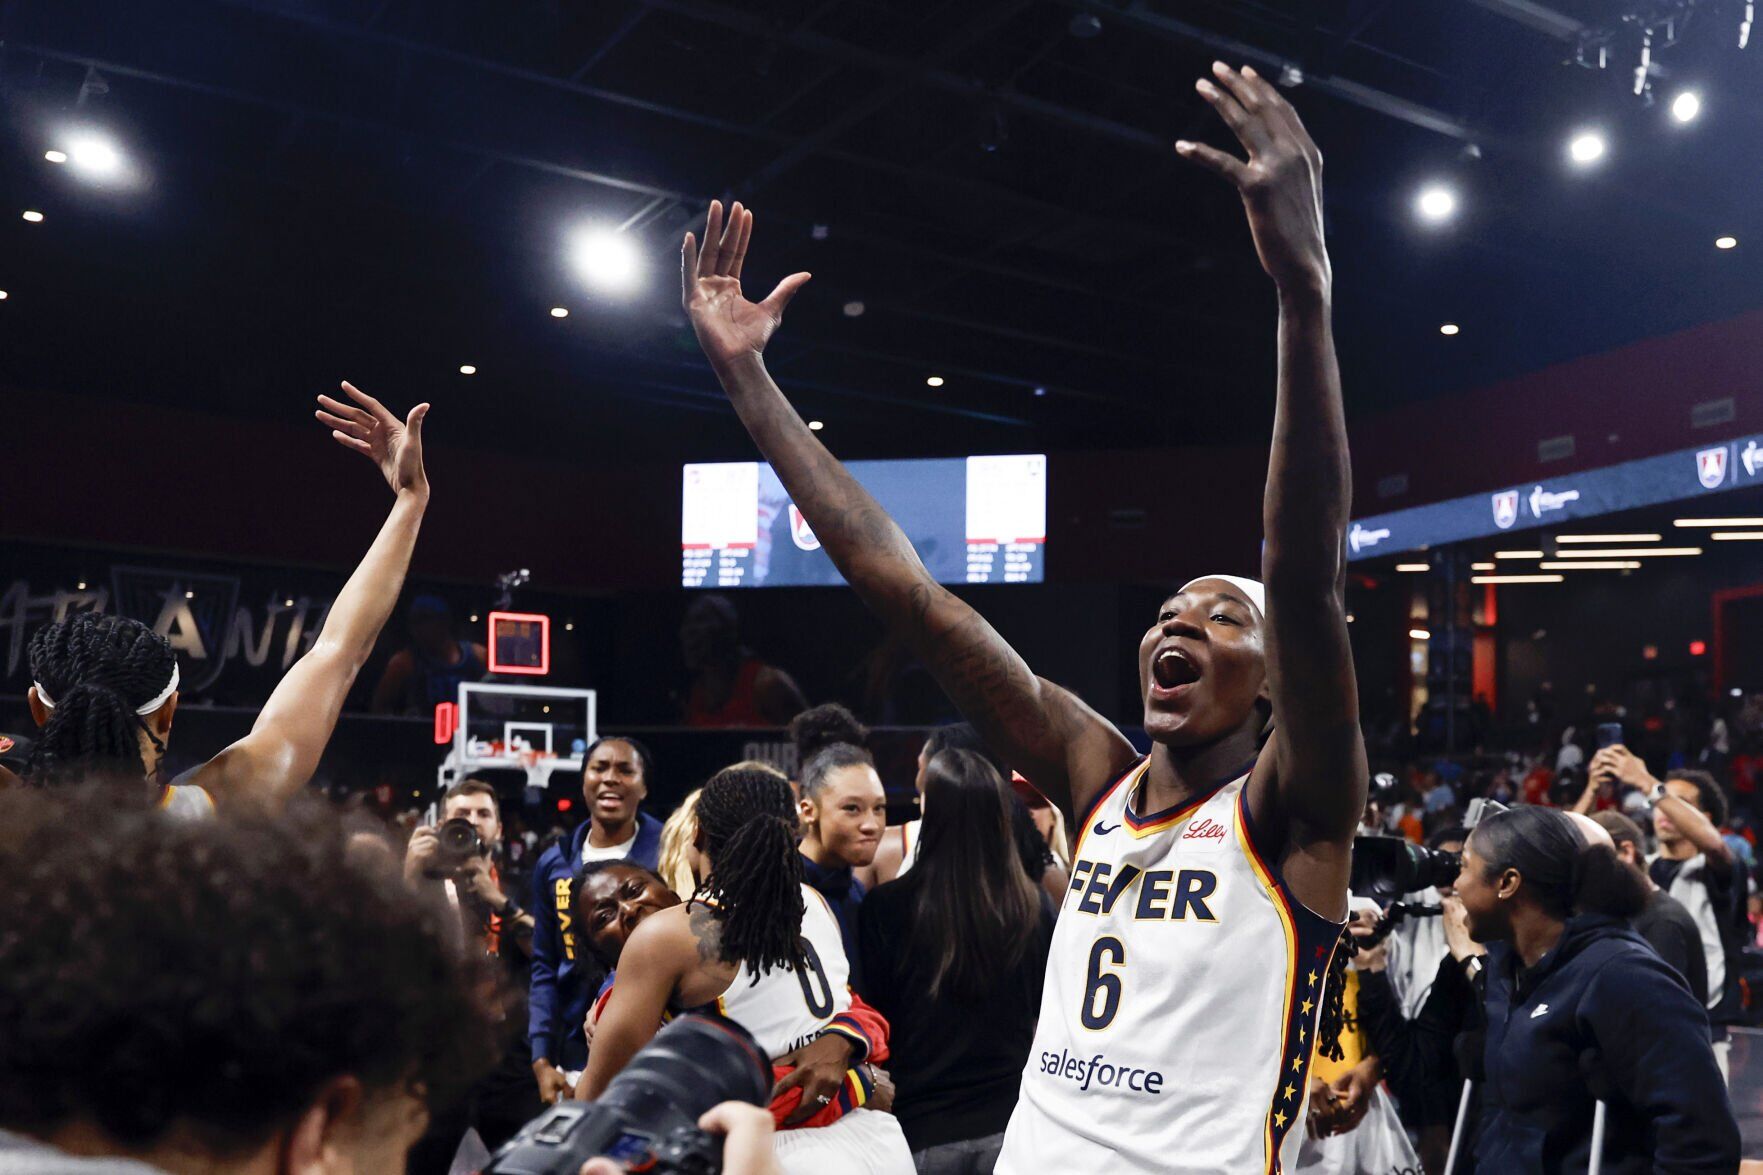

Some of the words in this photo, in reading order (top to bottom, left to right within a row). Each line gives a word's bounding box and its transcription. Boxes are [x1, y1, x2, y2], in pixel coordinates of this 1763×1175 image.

[1183, 818, 1227, 844] Lilly
[794, 934, 834, 1020] 0
[1080, 935, 1126, 1032] 6
[1040, 1048, 1164, 1095] salesforce
